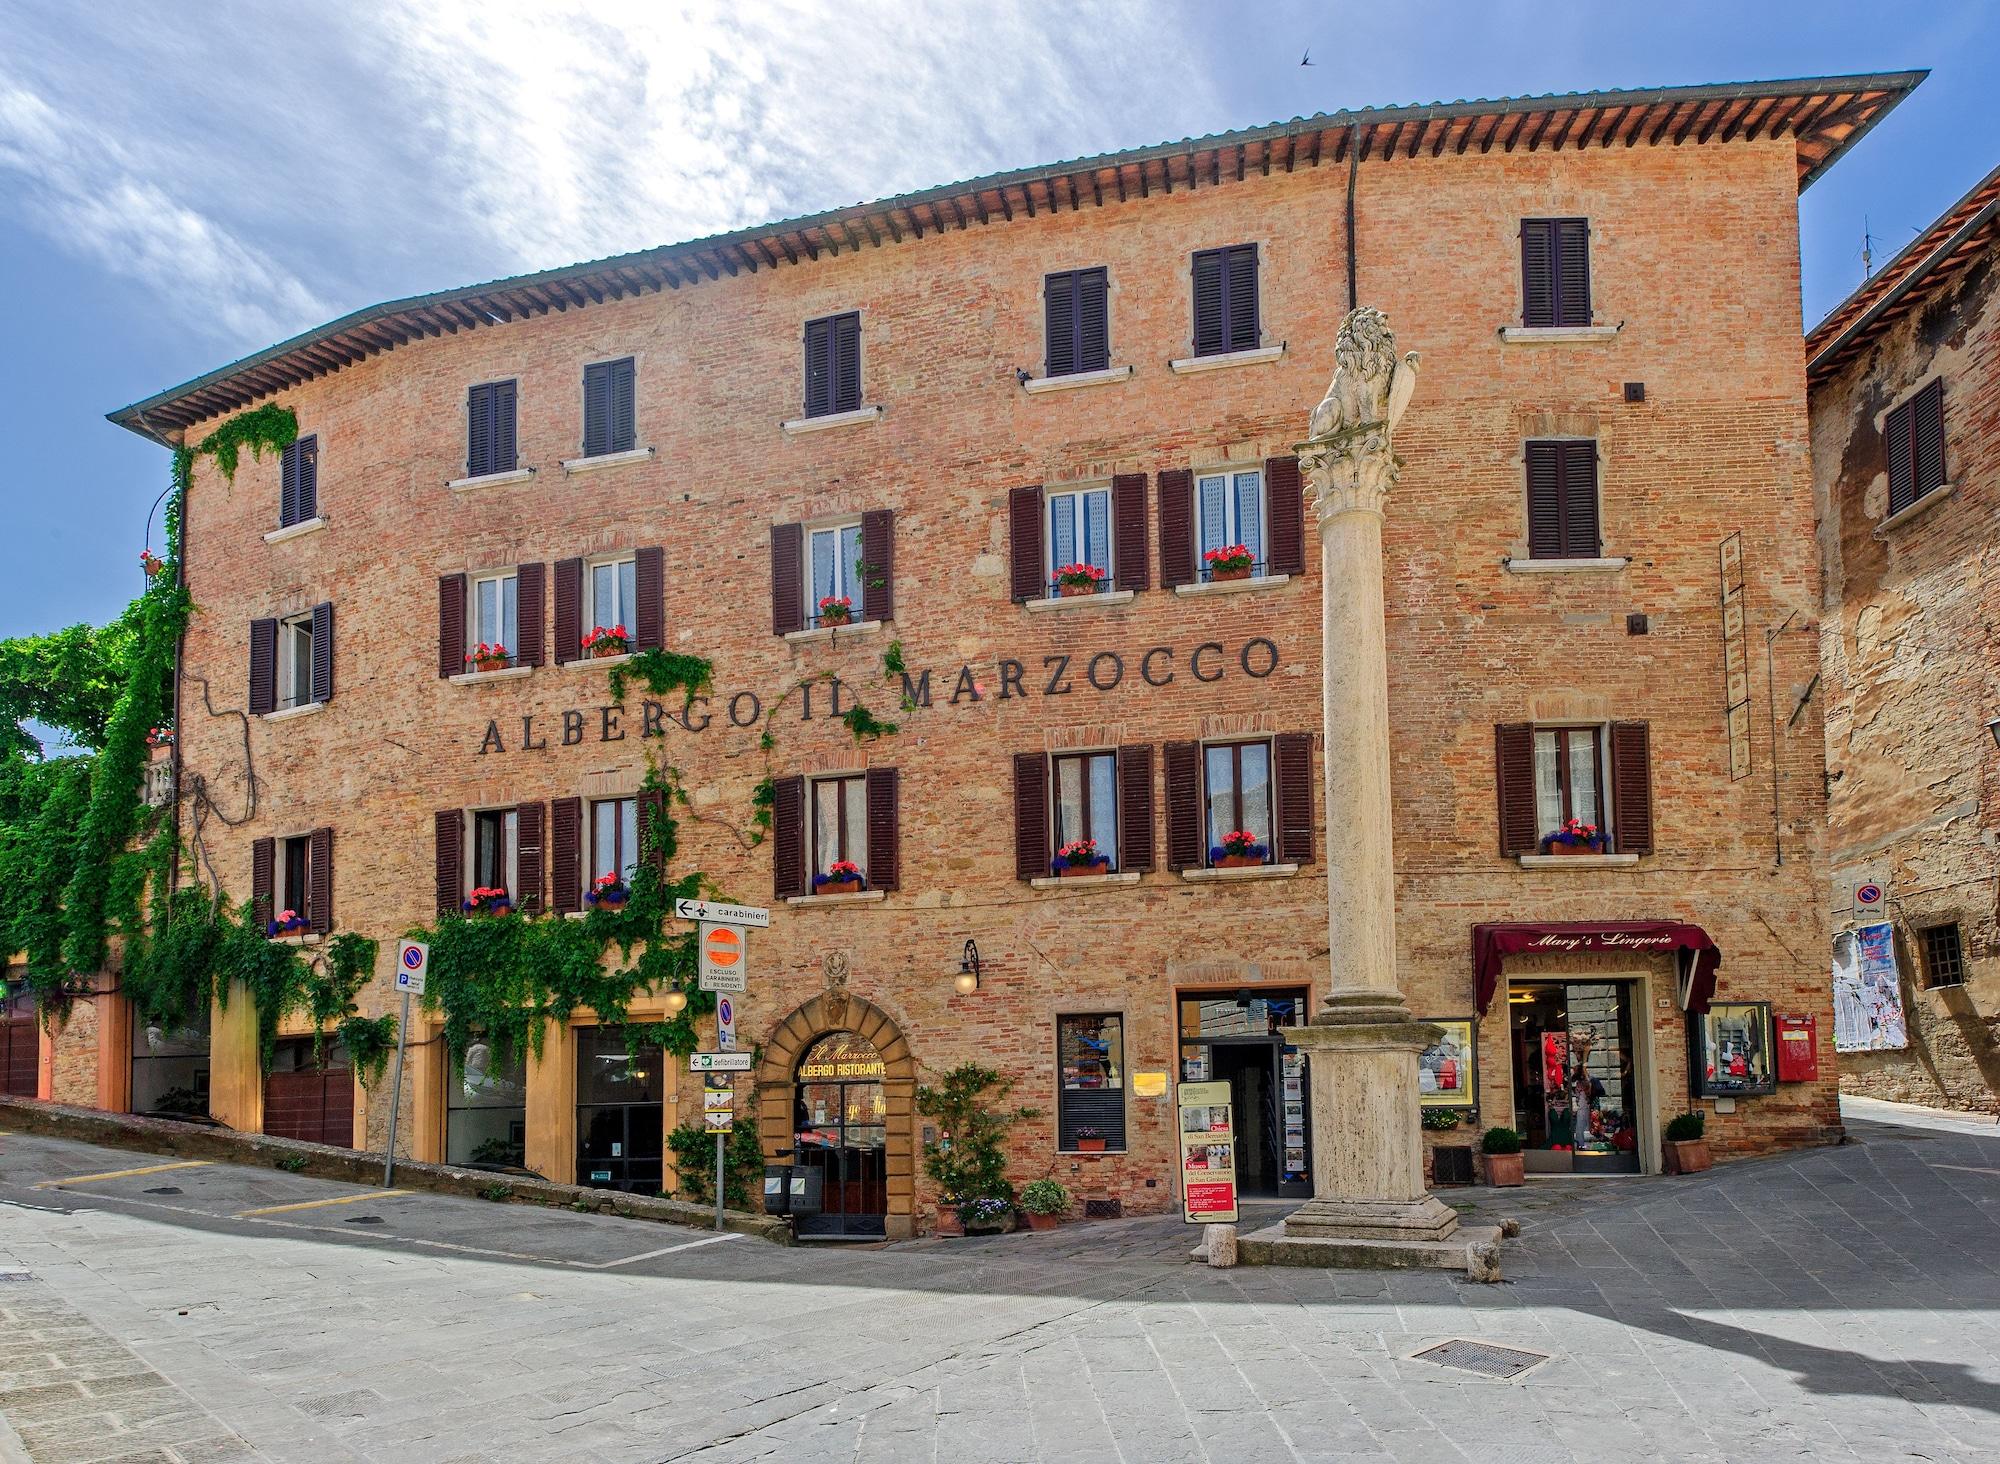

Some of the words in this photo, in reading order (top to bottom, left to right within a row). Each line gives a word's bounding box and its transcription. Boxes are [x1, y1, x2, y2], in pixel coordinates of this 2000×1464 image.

[478, 691, 761, 754] ALBERGO
[801, 678, 848, 720] IL
[900, 637, 1279, 708] MARZOCCO
[718, 909, 767, 920] carabinieri
[1528, 934, 1592, 950] Mary's
[1601, 933, 1672, 949] Lingerie
[714, 1058, 748, 1066] defibrillatore
[799, 1064, 834, 1077] ALBERGO
[837, 1062, 886, 1076] RISTORANTE
